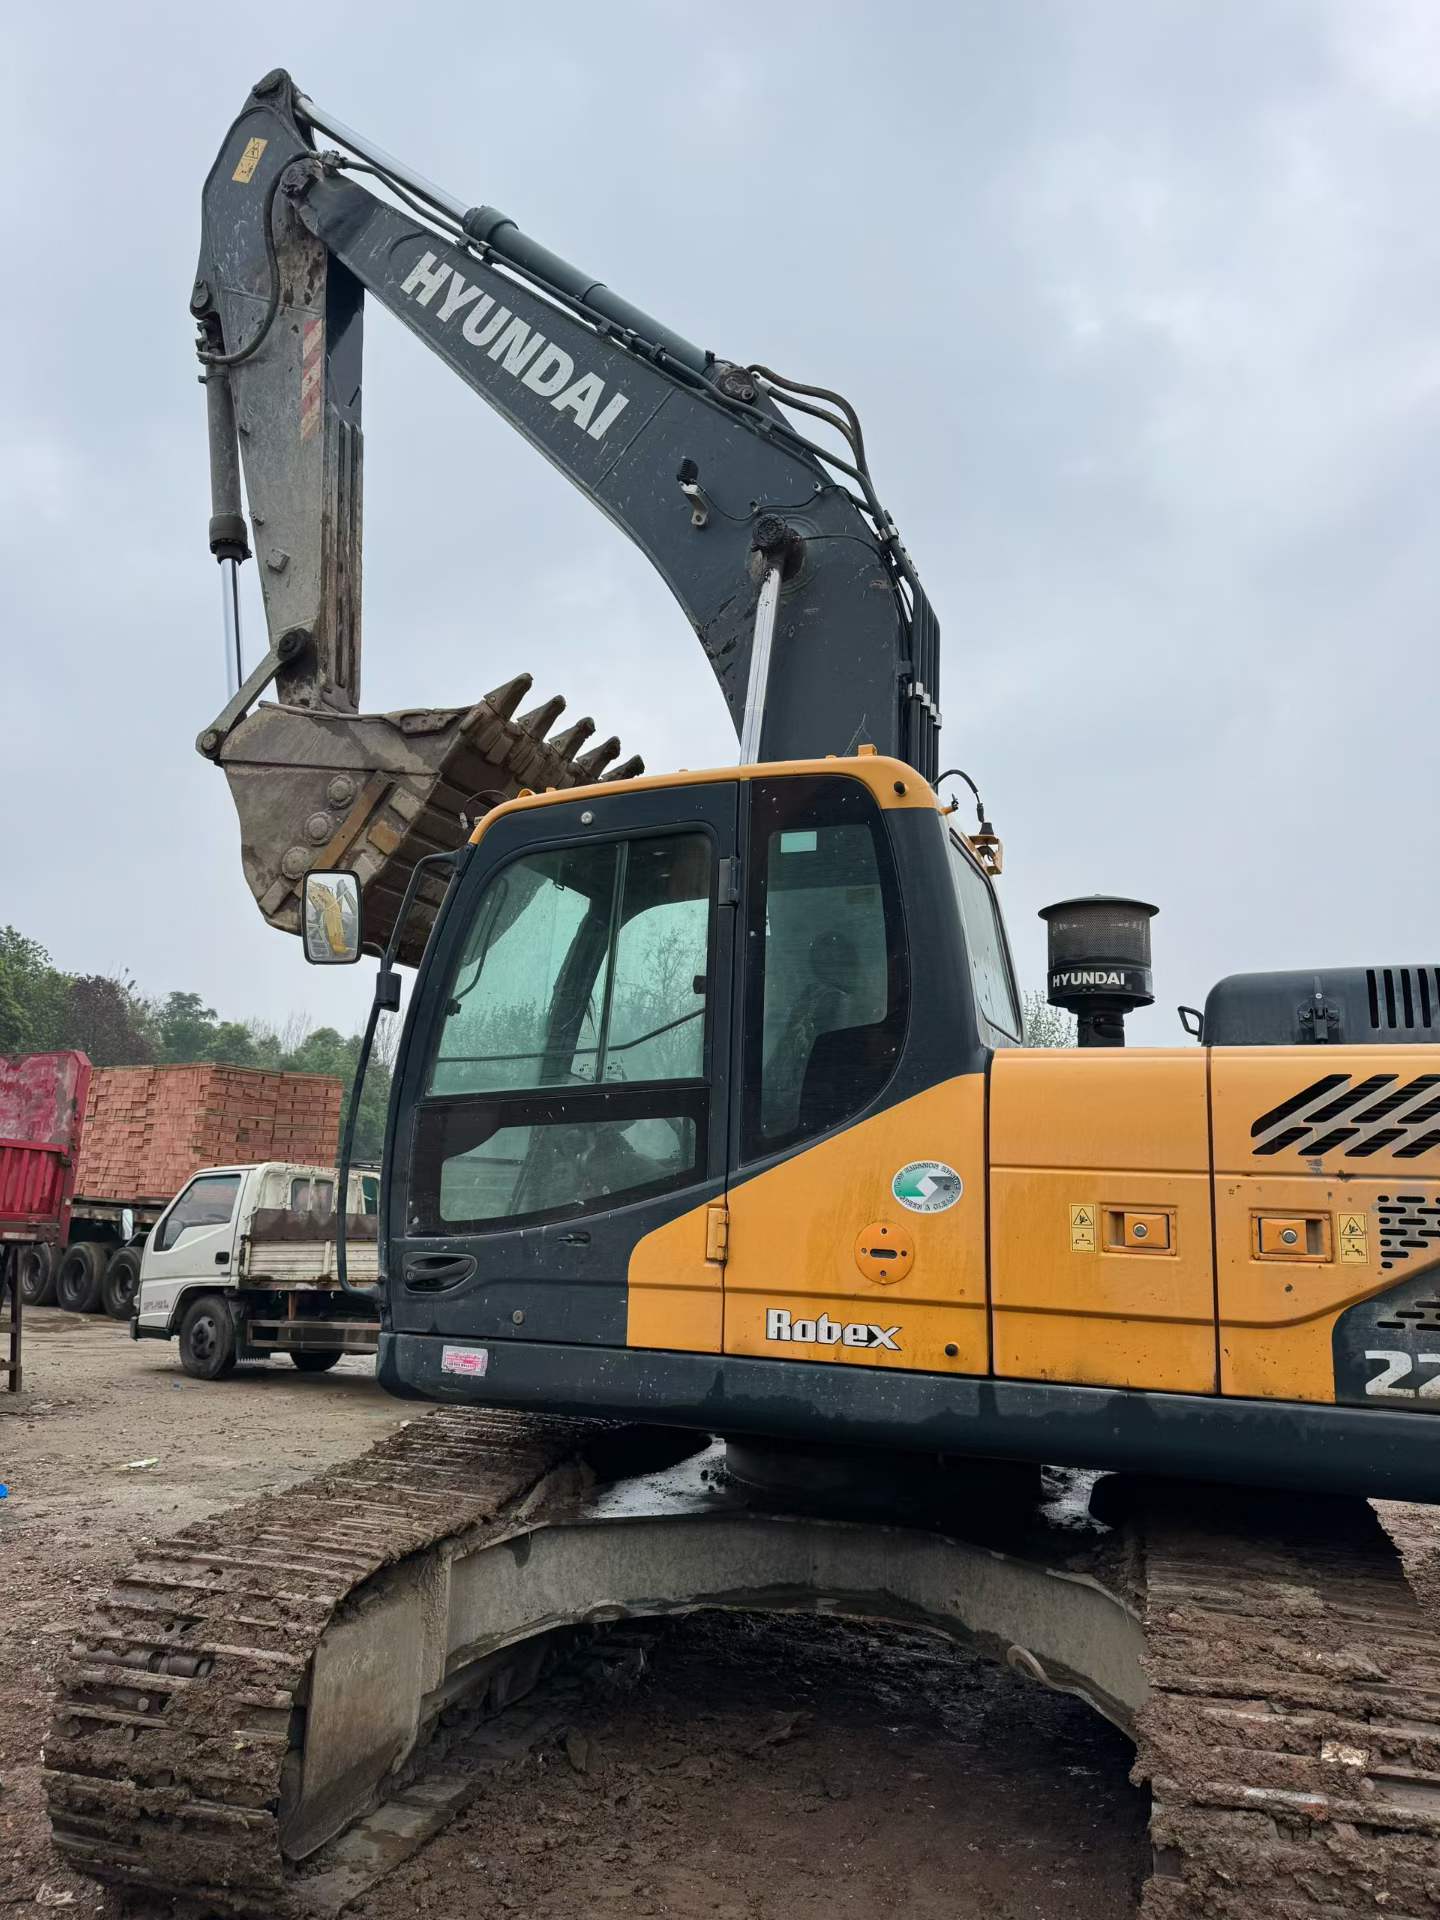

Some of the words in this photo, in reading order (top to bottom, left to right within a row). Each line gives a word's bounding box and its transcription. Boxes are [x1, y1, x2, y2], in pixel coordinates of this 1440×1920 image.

[400, 250, 630, 441] HYUNDAI
[1052, 972, 1125, 988] HYUNDAI
[765, 1308, 902, 1351] Robex
